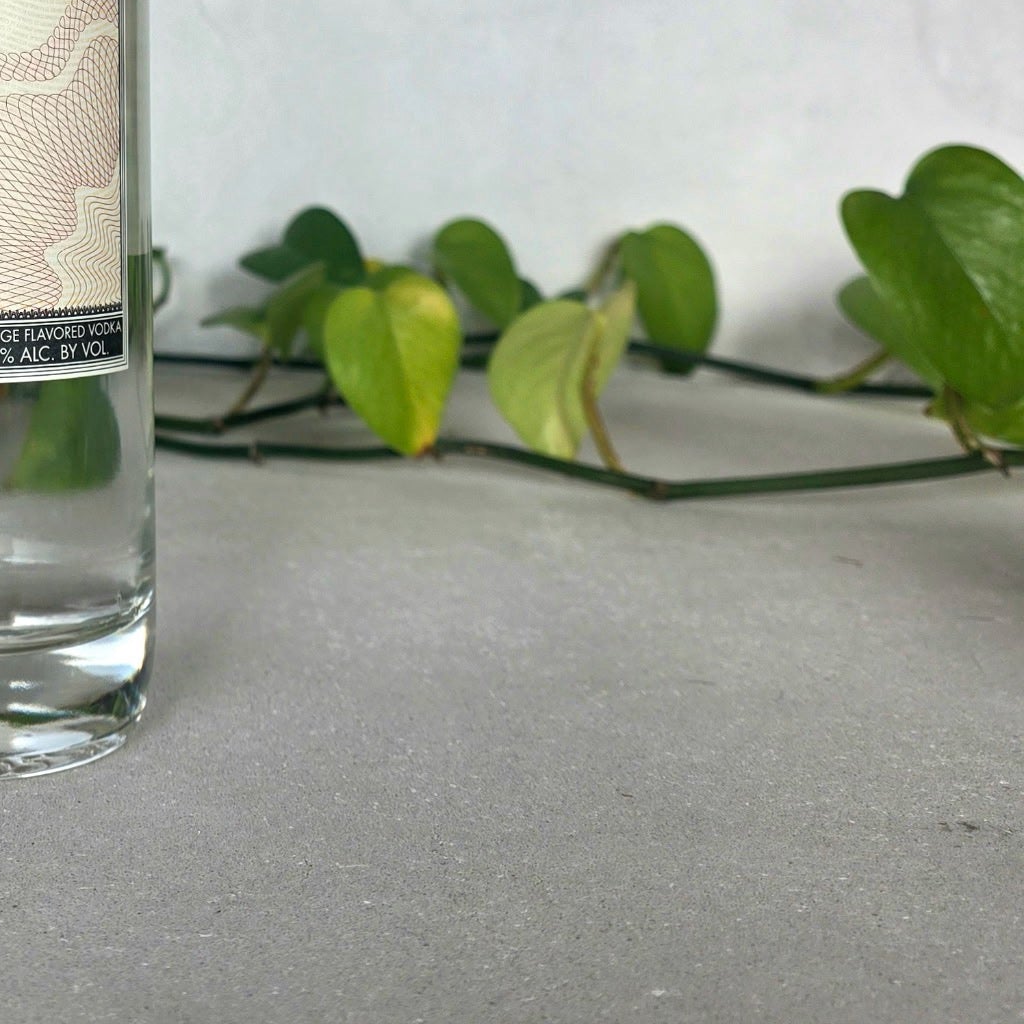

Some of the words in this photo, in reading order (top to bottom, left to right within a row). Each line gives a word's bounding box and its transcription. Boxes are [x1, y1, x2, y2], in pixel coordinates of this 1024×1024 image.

[25, 325, 85, 343] FLAVORED
[89, 322, 122, 338] VODKA
[20, 345, 56, 363] ALC.
[61, 343, 80, 360] BY
[82, 340, 110, 358] VOL.
